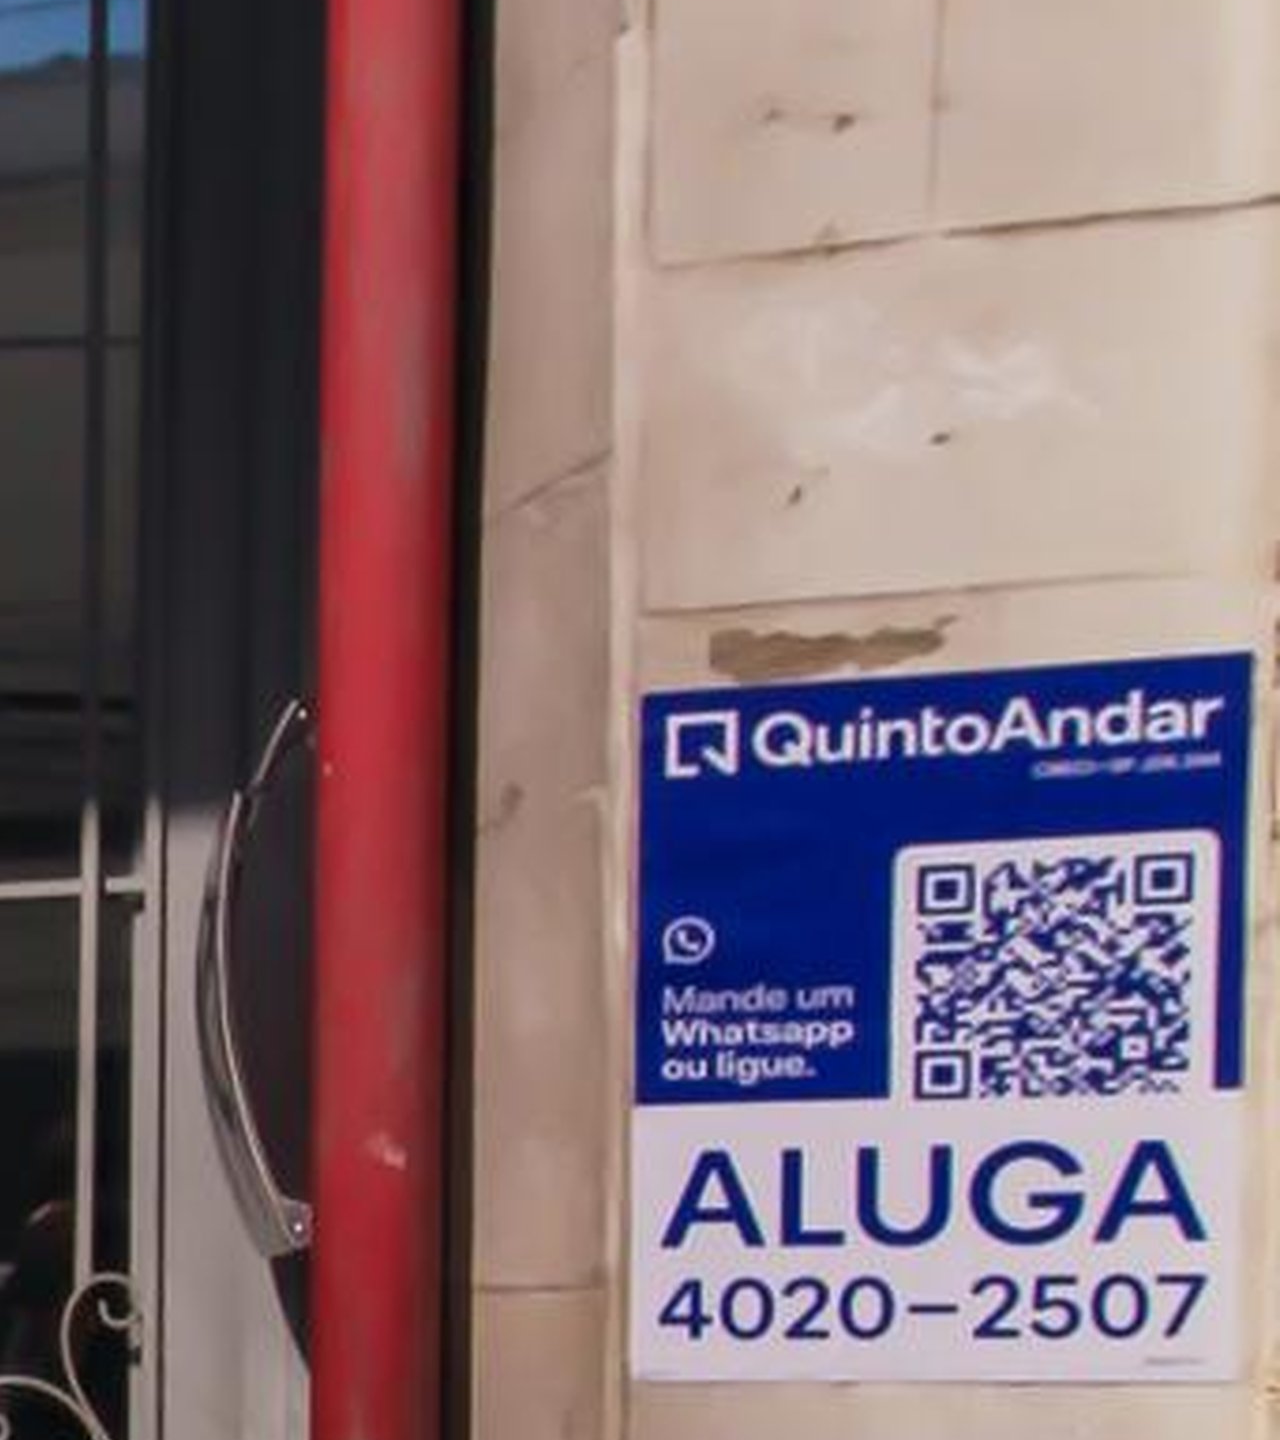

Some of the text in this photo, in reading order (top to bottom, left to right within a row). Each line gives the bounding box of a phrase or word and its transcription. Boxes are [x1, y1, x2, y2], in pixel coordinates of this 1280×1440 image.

[751, 689, 1224, 768] QuintoAndar
[662, 983, 854, 1014] Mande um
[661, 1018, 854, 1049] Whatsapp
[661, 1050, 816, 1085] ou ligue.
[659, 1139, 1208, 1250] ALUGA
[657, 1273, 1208, 1340] 4020-2507
